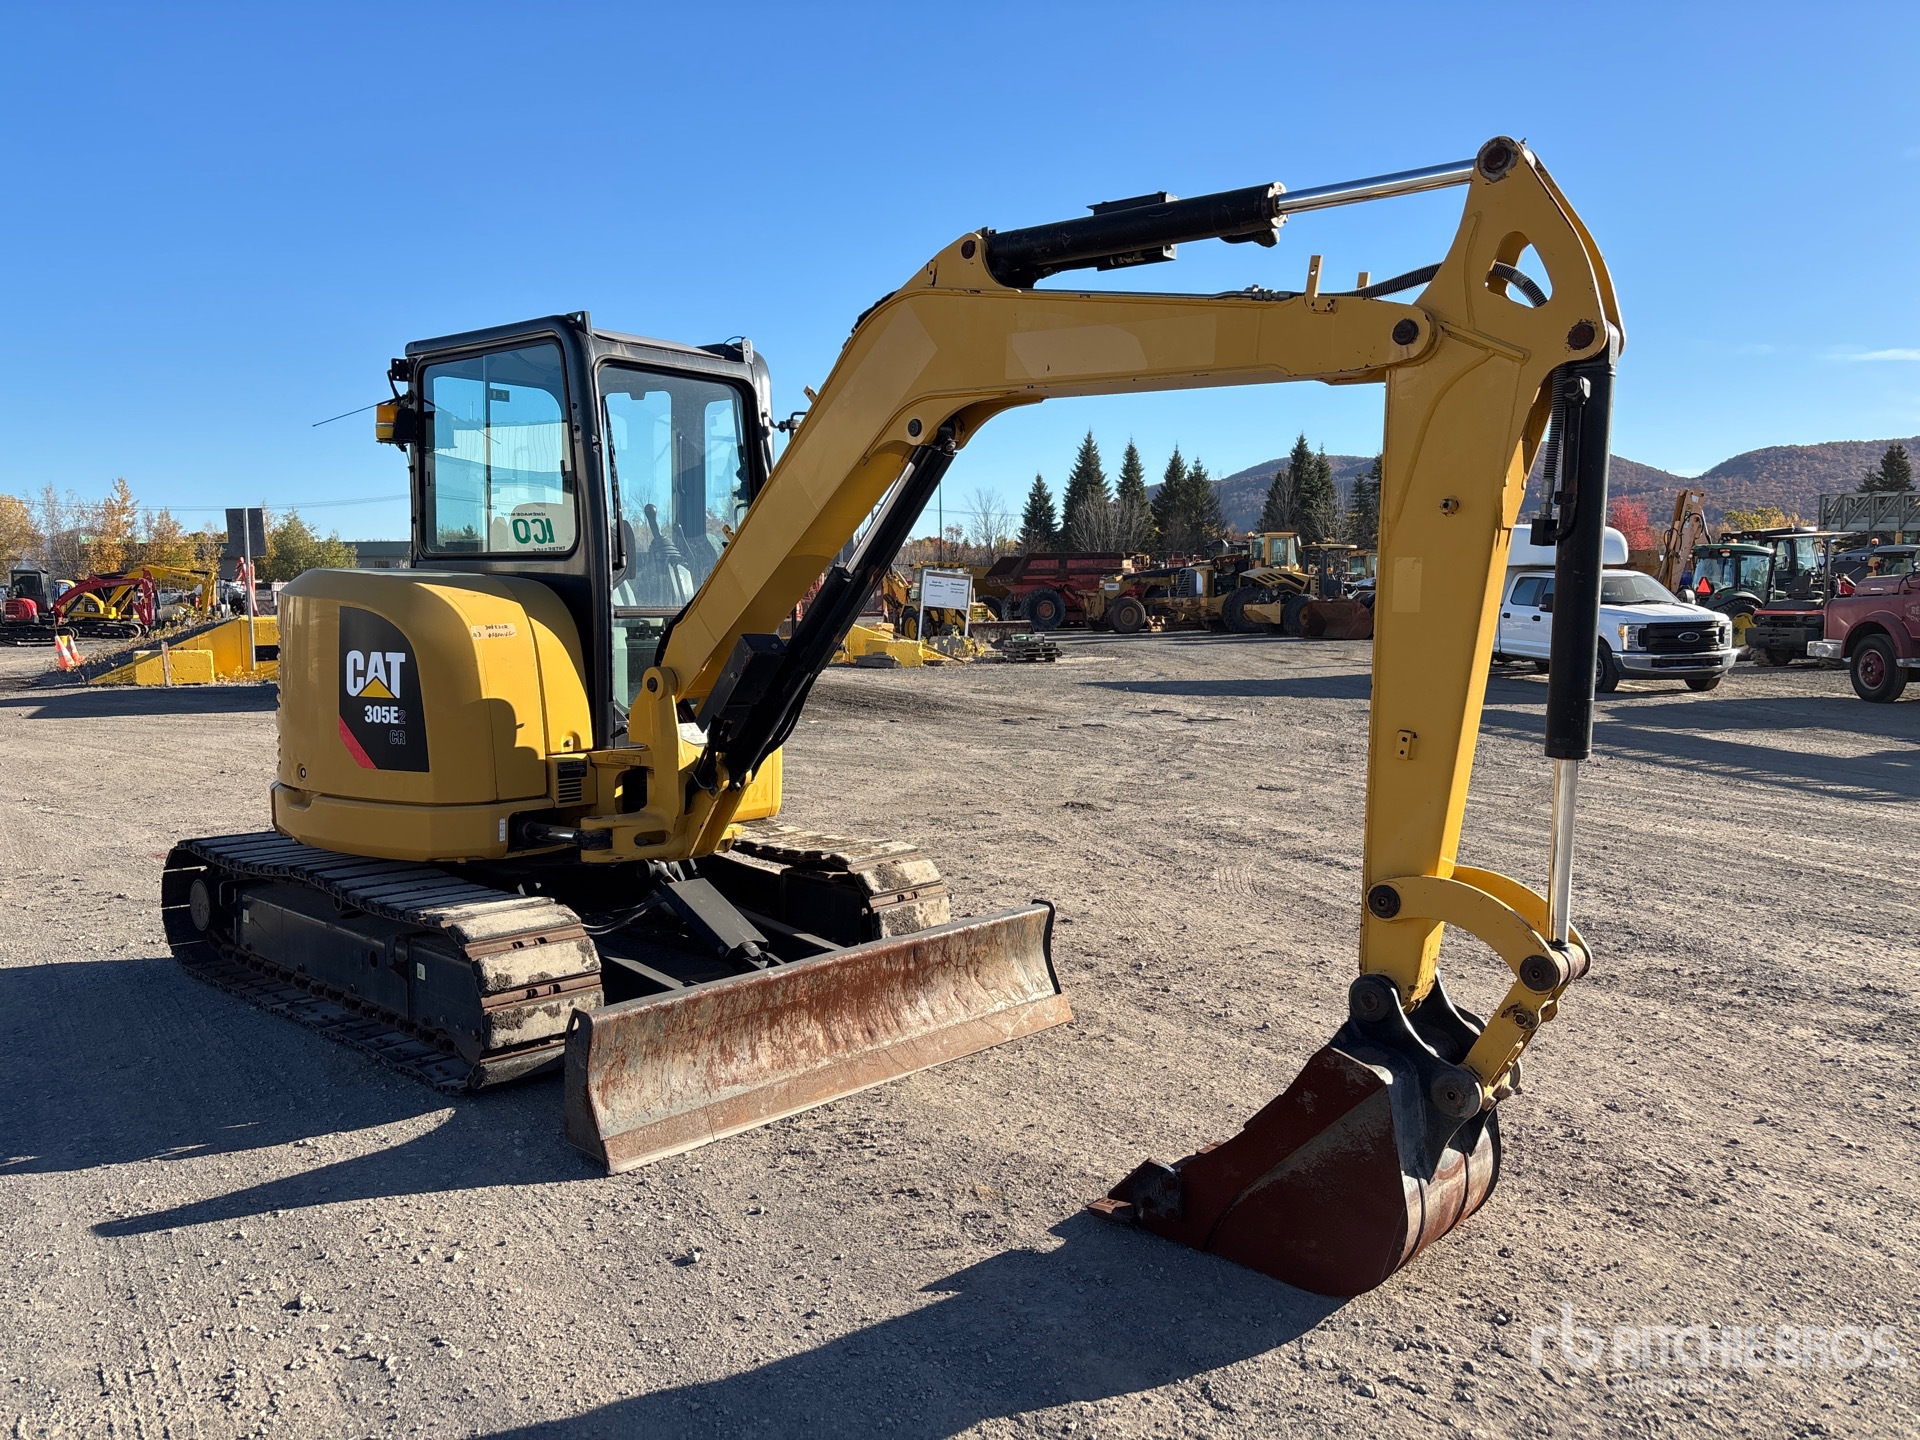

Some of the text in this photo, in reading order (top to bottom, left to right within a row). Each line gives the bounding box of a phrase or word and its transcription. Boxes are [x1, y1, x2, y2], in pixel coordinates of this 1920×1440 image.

[346, 650, 406, 699] CAT
[364, 705, 406, 725] 305E2
[389, 729, 406, 745] CR
